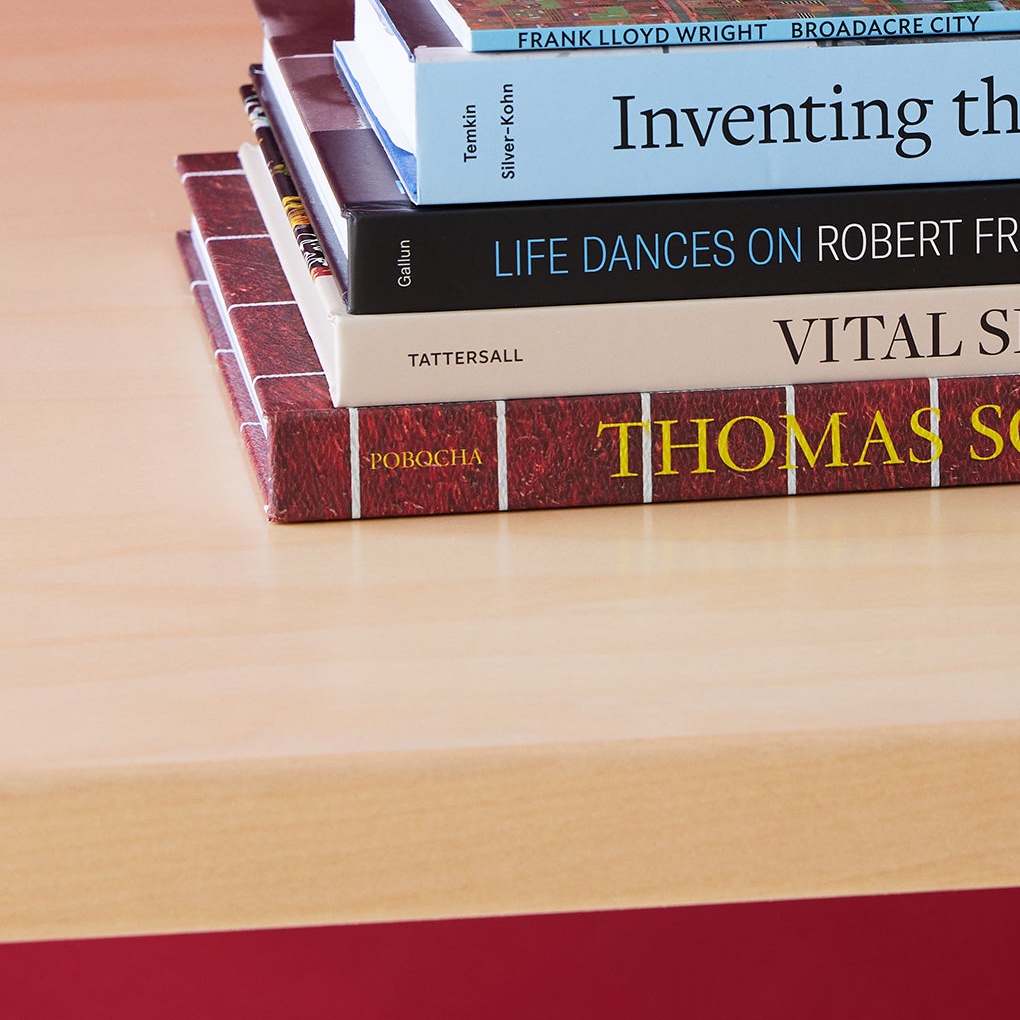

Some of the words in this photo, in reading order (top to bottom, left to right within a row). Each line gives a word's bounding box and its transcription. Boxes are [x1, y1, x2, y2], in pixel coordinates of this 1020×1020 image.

[518, 30, 592, 48] FRANK
[599, 27, 670, 46] LLOYD
[675, 23, 767, 43] WRIGHT
[791, 17, 923, 39] BROADACRE
[930, 15, 981, 33] CITY
[463, 104, 477, 163] Temkin
[500, 83, 515, 180] Silver-Kohn
[612, 84, 934, 160] Inventing
[397, 239, 412, 288] Gallun
[494, 237, 569, 277] LIFE
[582, 229, 736, 274] DANCES
[748, 226, 803, 266] ON
[817, 220, 963, 262] ROBERT
[408, 348, 524, 368] TATTERSALL
[772, 312, 963, 366] VITAL
[370, 448, 484, 471] POBOCHA
[596, 408, 944, 480] THOMAS
